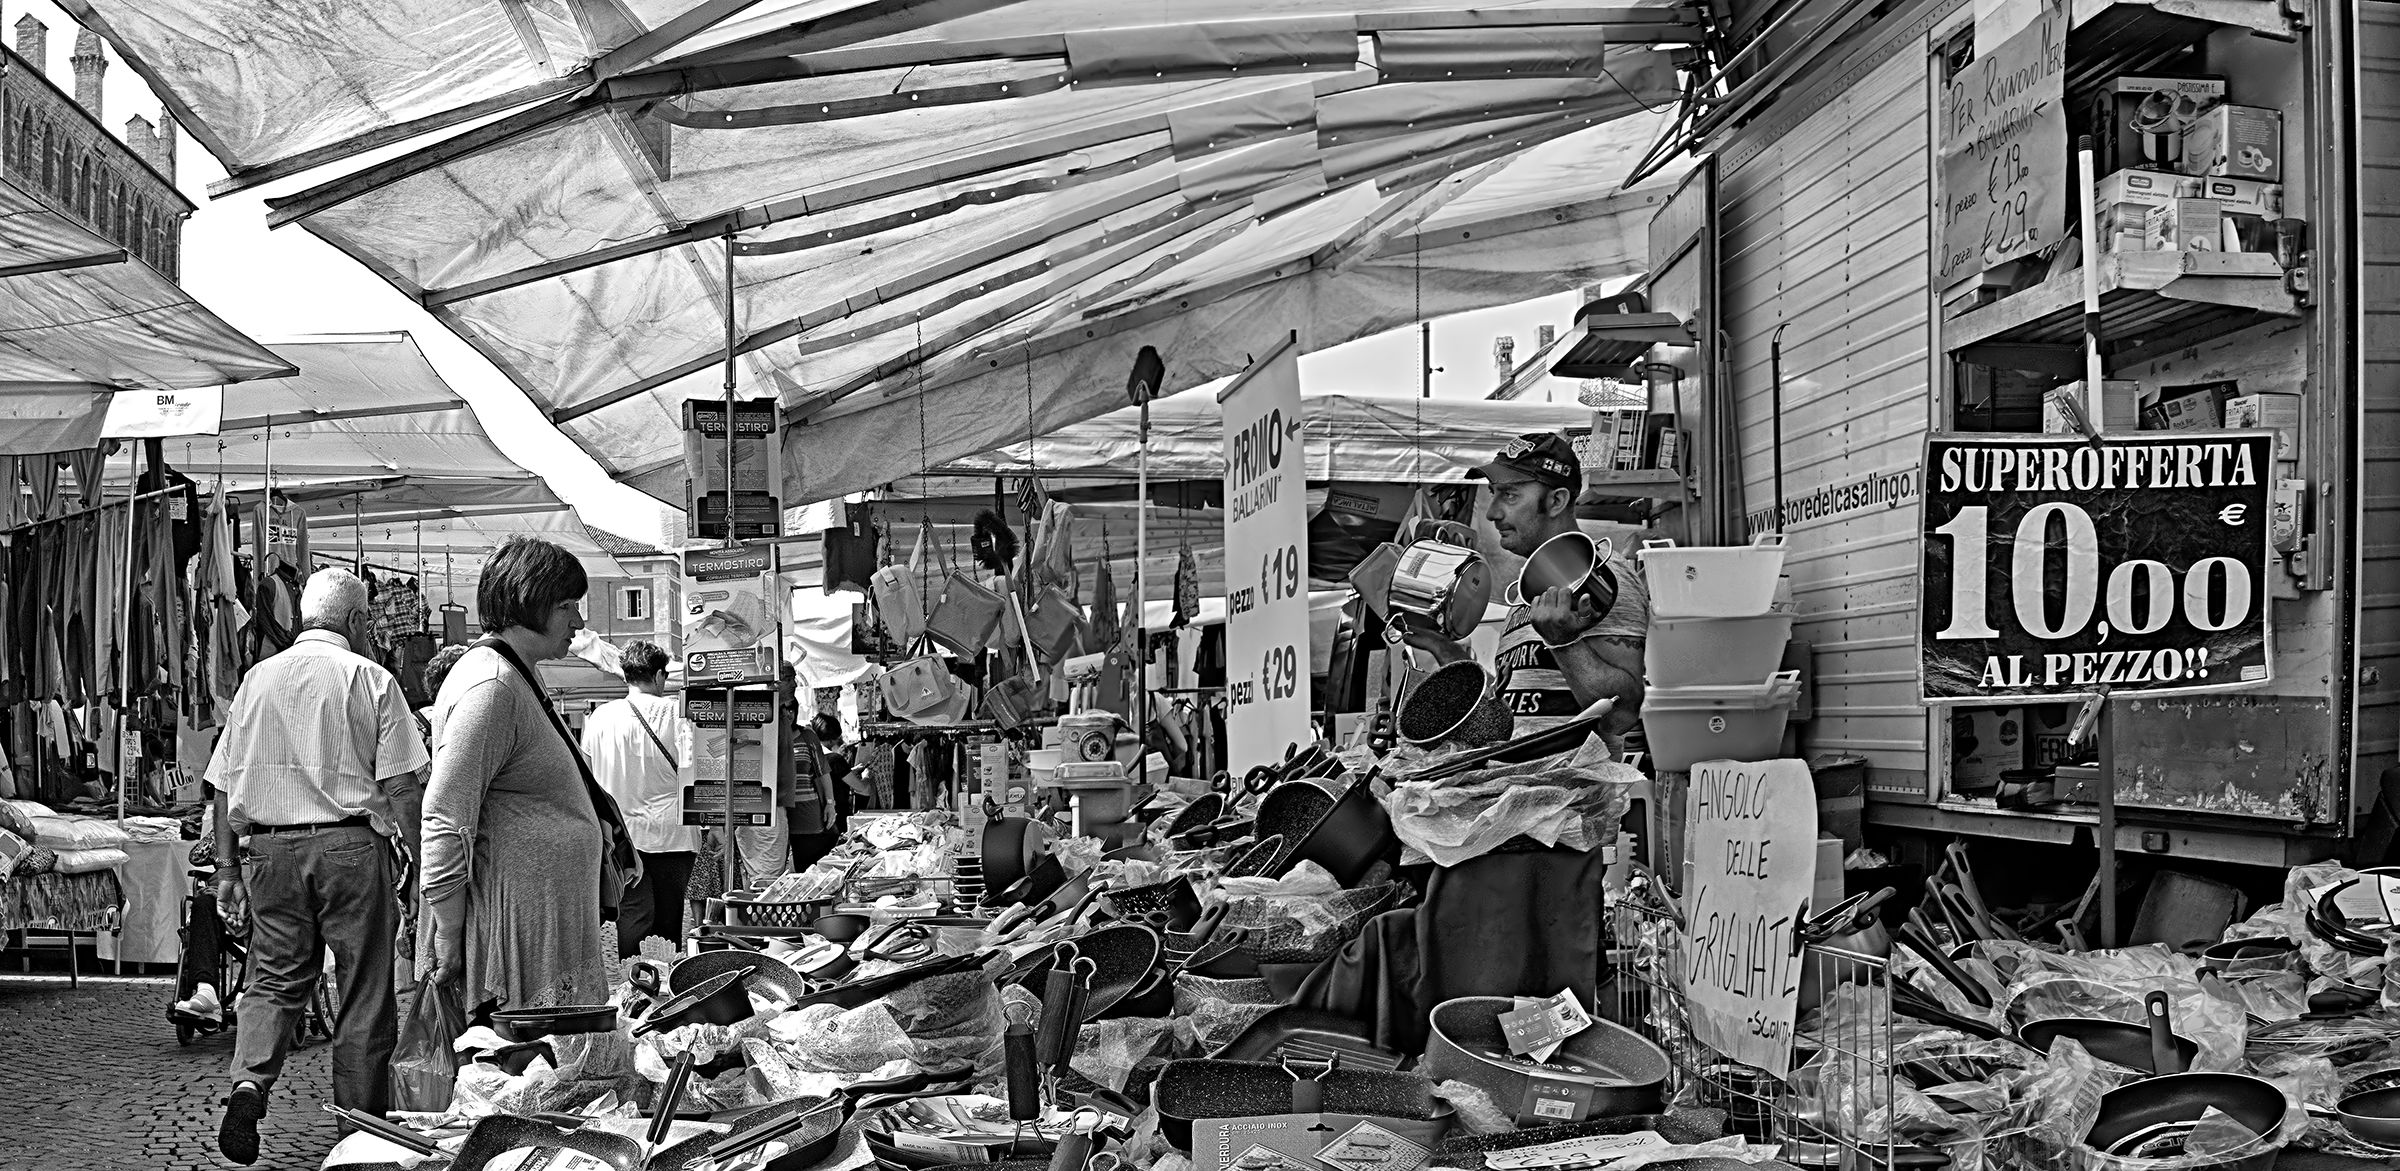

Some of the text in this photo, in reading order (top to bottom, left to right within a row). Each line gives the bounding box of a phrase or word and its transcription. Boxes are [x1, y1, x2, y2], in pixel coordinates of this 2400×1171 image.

[1950, 81, 1976, 141] PER
[156, 395, 175, 406] BM
[700, 422, 769, 432] TERSTIRO
[1233, 407, 1282, 492] PROMO
[1940, 442, 2257, 493] SUPEROFFERTA
[2218, 503, 2247, 526] €
[692, 558, 764, 573] TERMOSTIRO
[1935, 501, 2252, 646] 10,00
[1230, 586, 1255, 624] pezzo
[1977, 646, 2209, 688] AL PEZZO!!
[1231, 671, 1254, 714] pezzi
[692, 711, 766, 722] TERMSTIRO
[1697, 768, 1767, 824] ANGOLO
[1726, 839, 1771, 880] DELLE
[1689, 885, 1798, 1001] GRIGLIATE
[1218, 1122, 1230, 1170] VERDURA
[1231, 1121, 1288, 1132] ACCIAIO INOX
